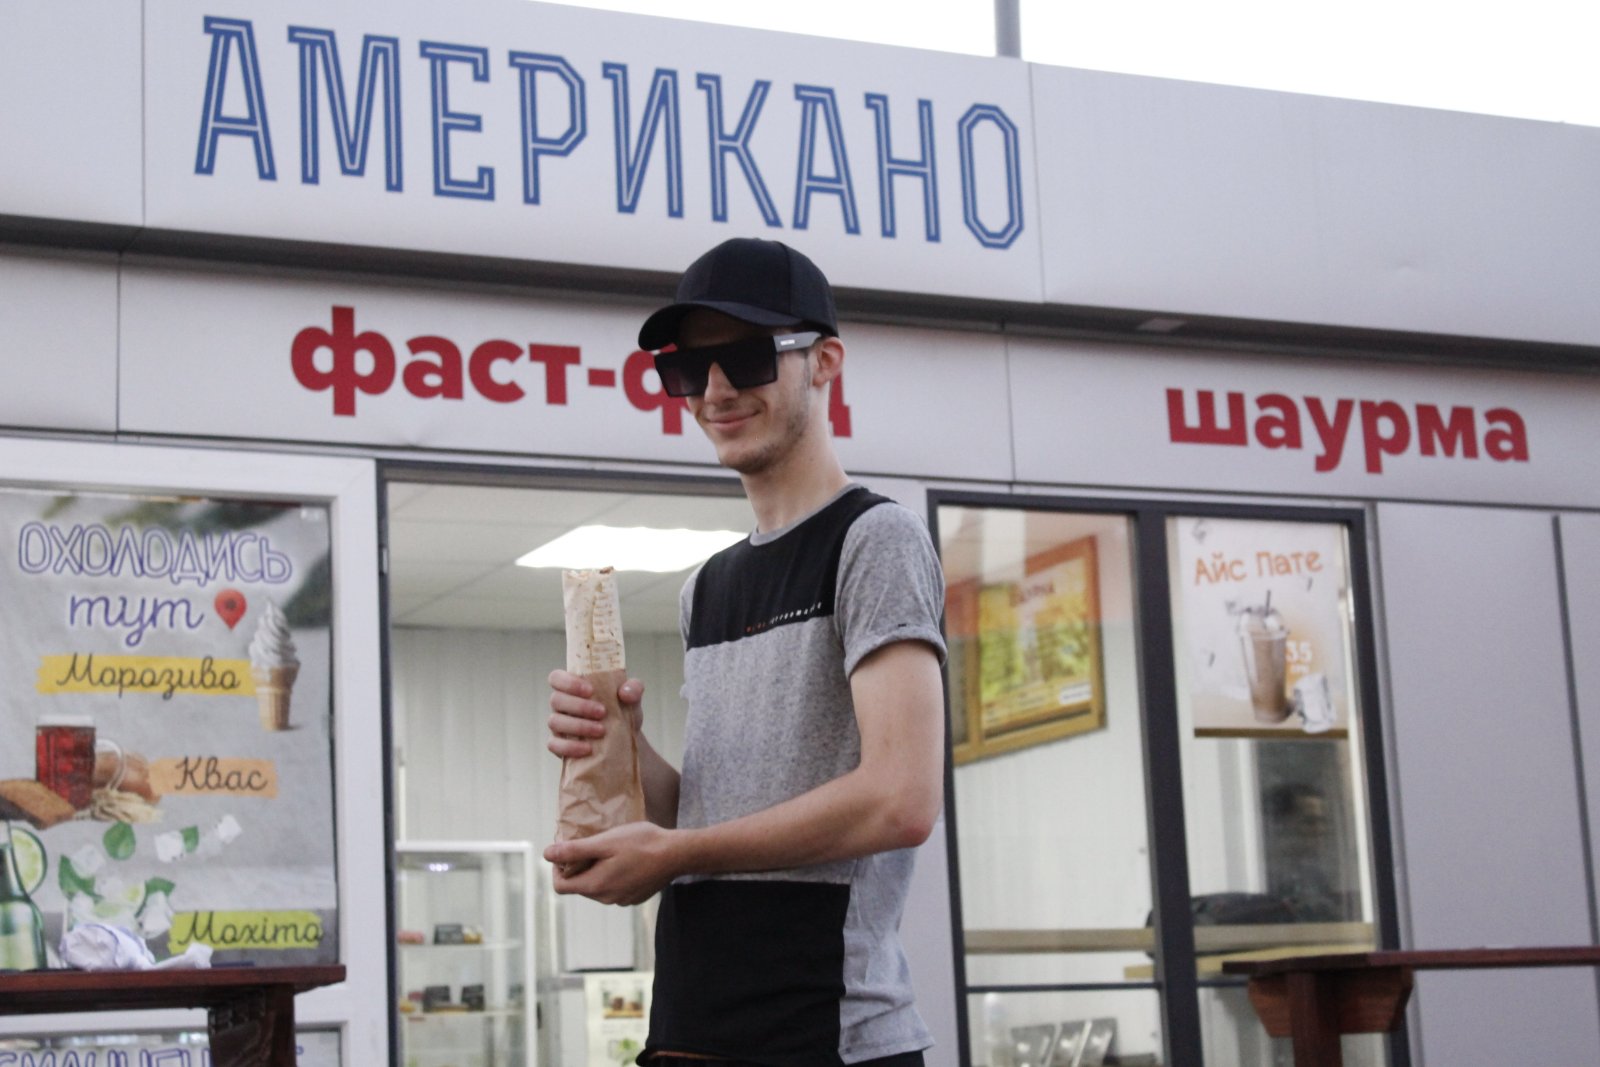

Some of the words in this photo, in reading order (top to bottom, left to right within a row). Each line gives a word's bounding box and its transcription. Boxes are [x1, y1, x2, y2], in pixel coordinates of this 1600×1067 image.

[195, 15, 1024, 250] АМЕРИКАНО
[1165, 387, 1530, 475] шаурма
[18, 521, 293, 587] ОХОЛОДИСЬ
[1194, 551, 1248, 586] Айс
[69, 594, 205, 647] тут
[174, 755, 268, 791] Квас
[177, 910, 325, 945] Мохіто
